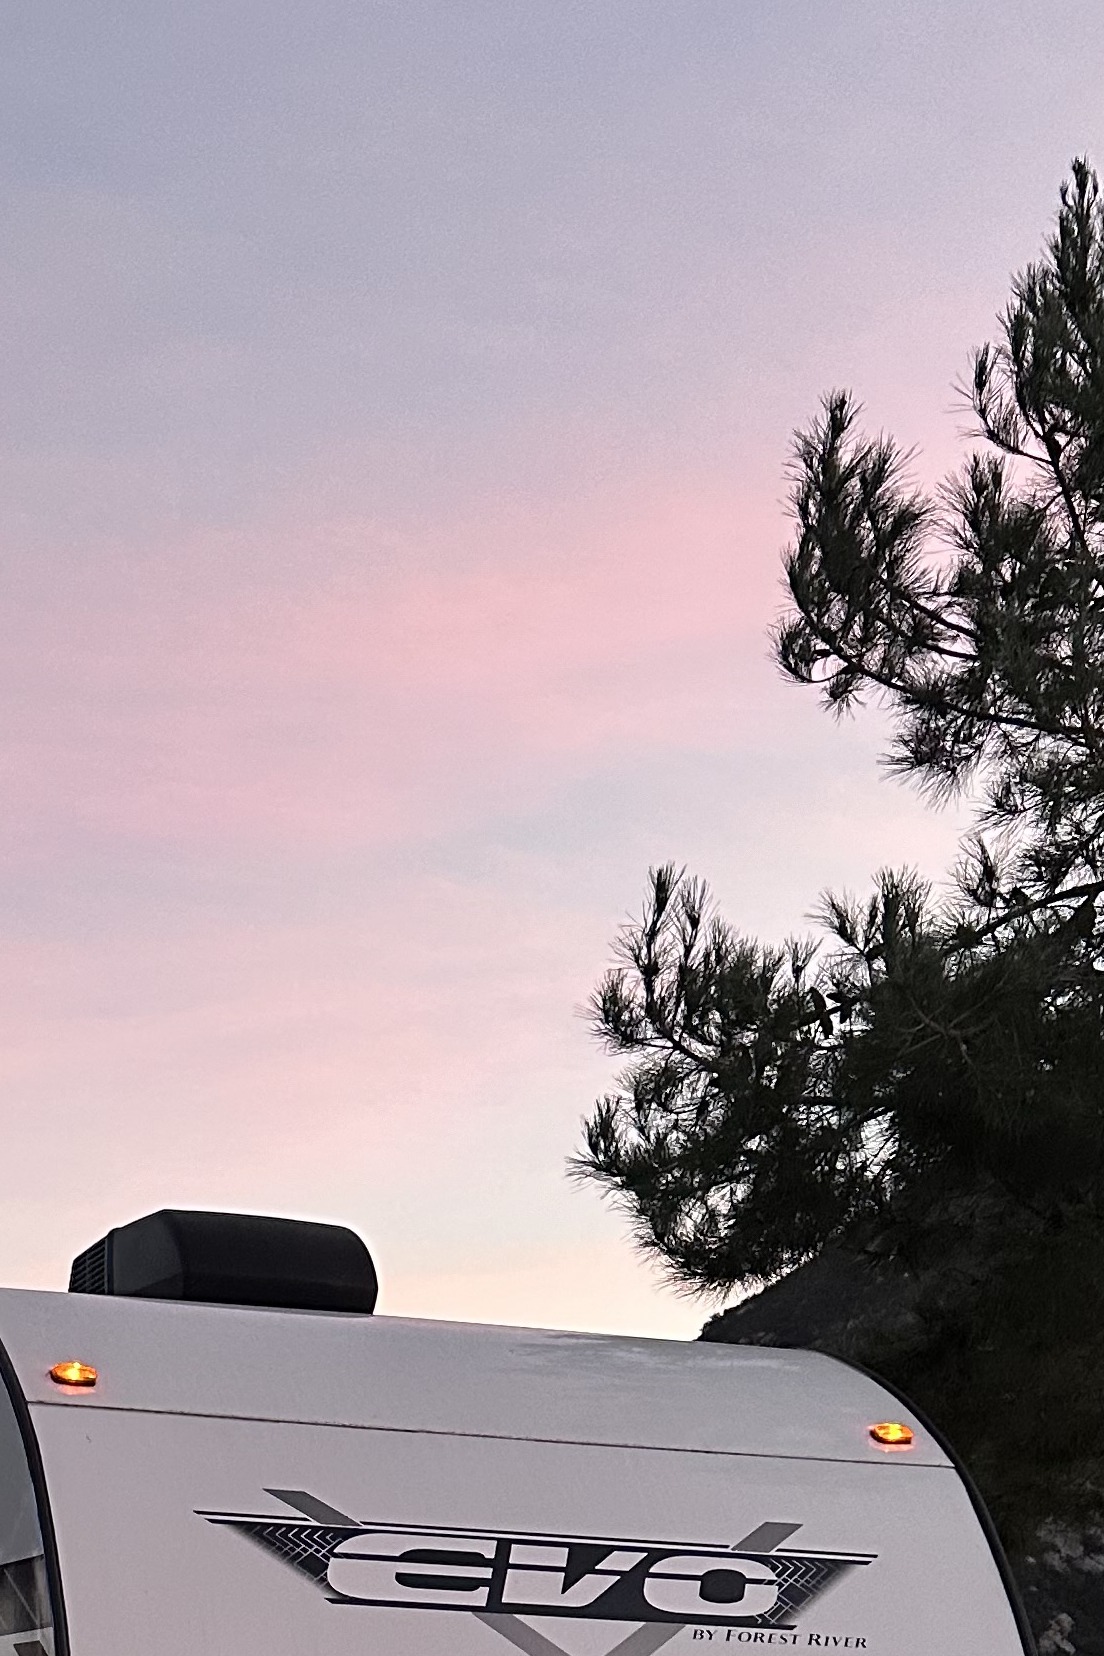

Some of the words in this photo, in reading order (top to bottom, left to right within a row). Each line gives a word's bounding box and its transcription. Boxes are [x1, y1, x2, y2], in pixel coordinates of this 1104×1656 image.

[327, 1532, 779, 1617] EVO
[692, 1628, 718, 1641] BY
[725, 1629, 801, 1646] FOREST
[808, 1632, 868, 1649] RIVER
